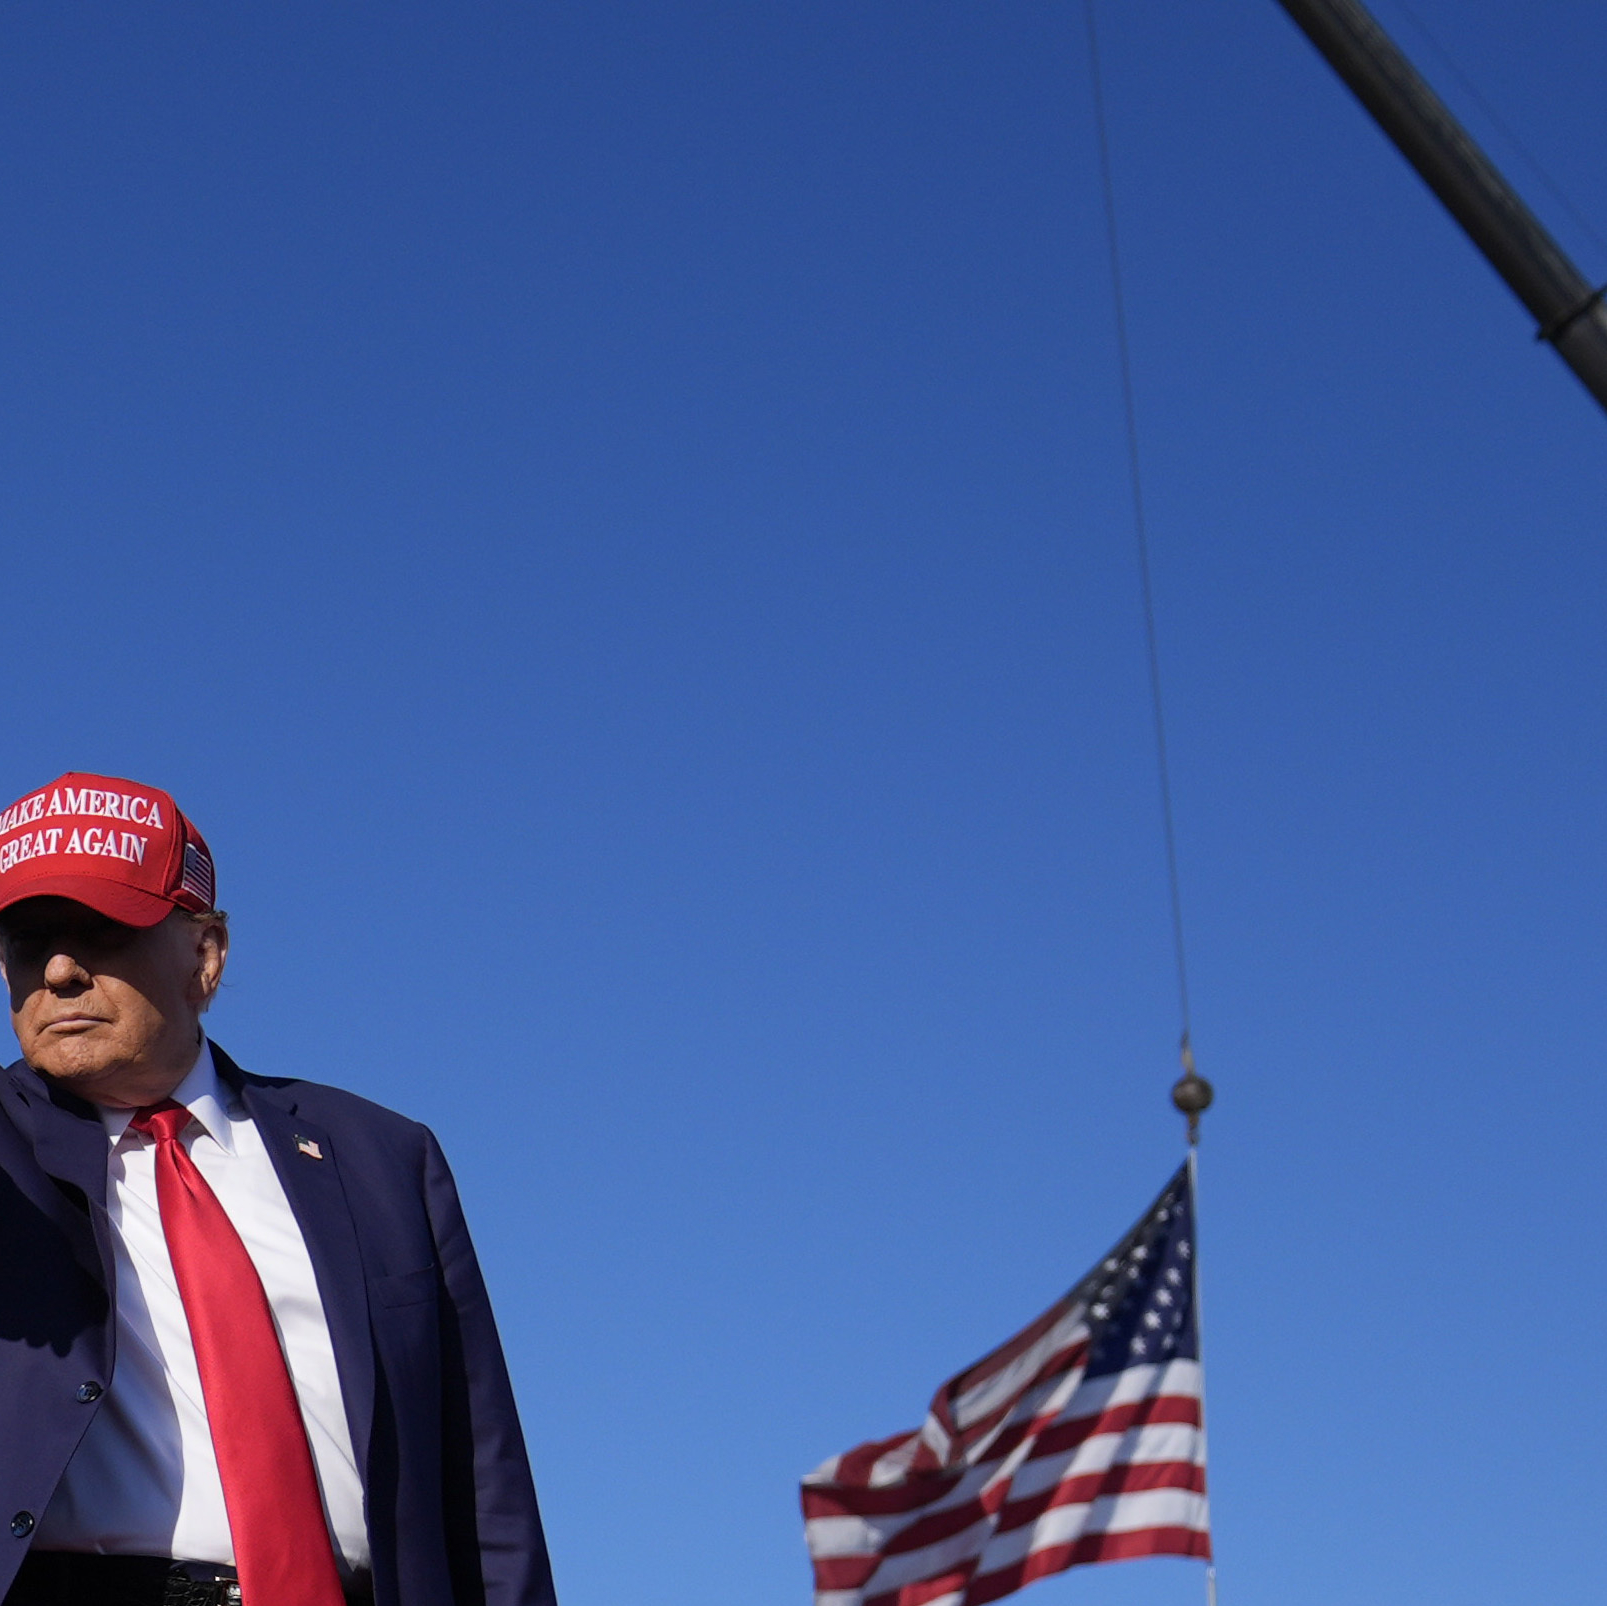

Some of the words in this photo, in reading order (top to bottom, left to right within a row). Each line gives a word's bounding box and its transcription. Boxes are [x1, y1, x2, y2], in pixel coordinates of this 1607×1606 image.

[46, 787, 164, 829] AMERICA
[0, 828, 62, 874] GREAT
[64, 828, 148, 866] AGAIN
